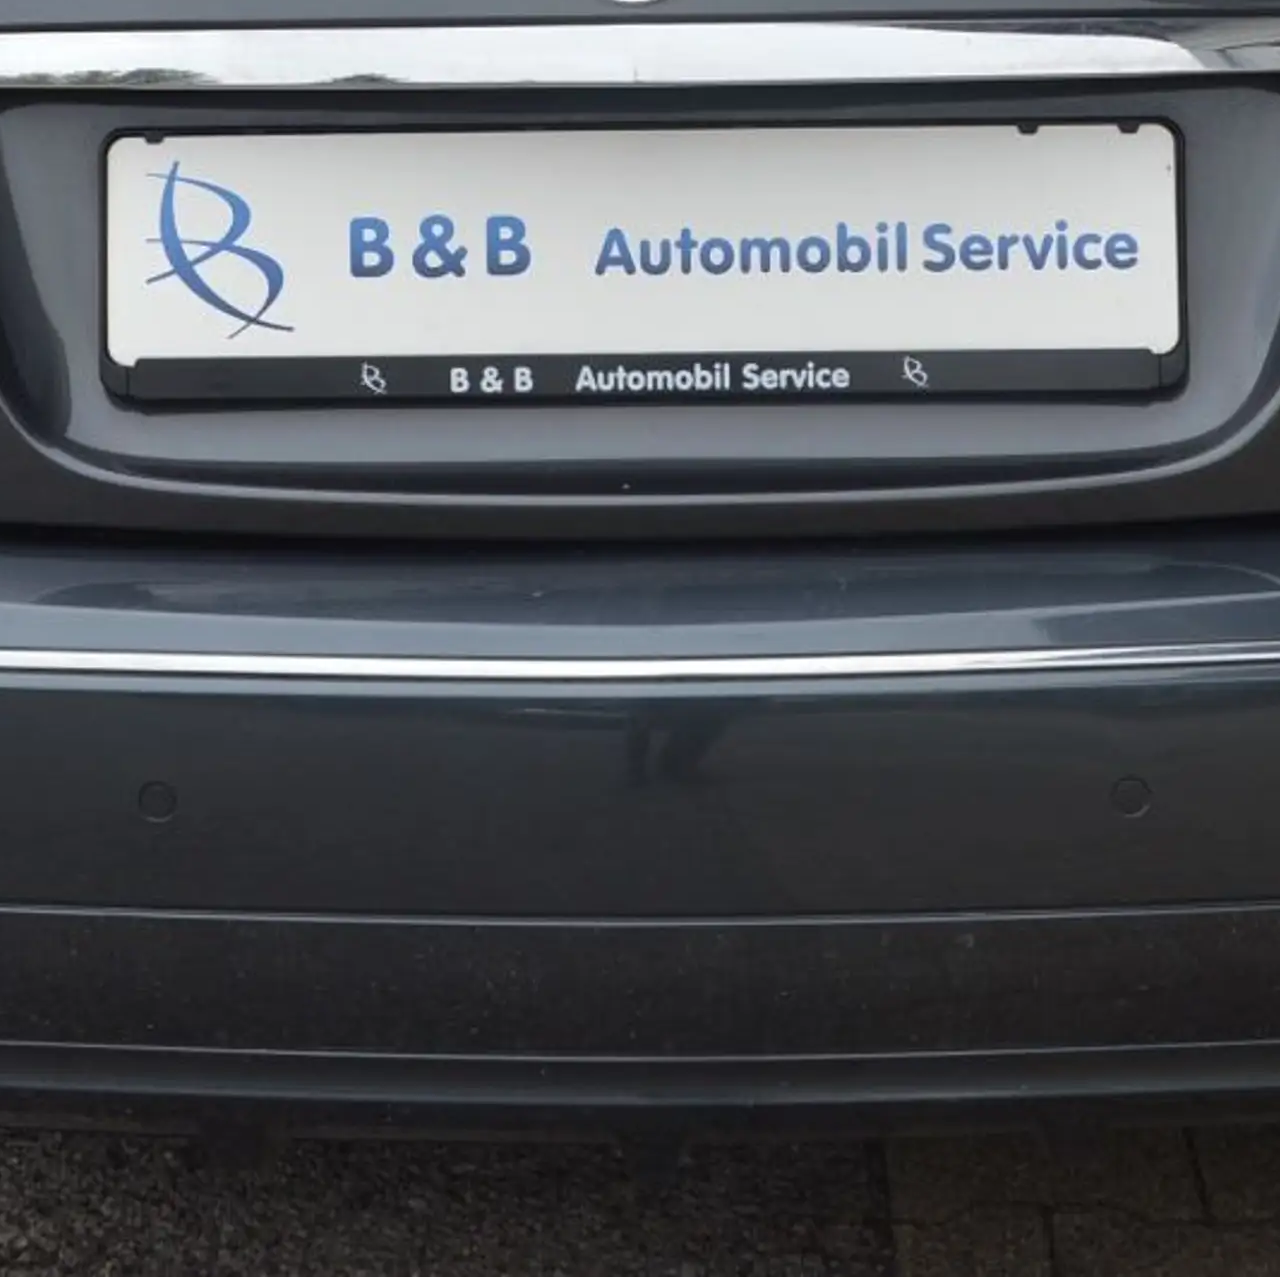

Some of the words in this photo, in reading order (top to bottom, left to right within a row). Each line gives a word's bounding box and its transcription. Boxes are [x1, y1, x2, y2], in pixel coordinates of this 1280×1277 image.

[348, 216, 396, 279] B
[411, 213, 470, 280] &
[485, 214, 533, 278] B
[593, 220, 910, 278] Automobil
[921, 219, 1140, 274] Service
[450, 367, 470, 393] B
[479, 366, 505, 393] &
[513, 366, 534, 393] B
[575, 362, 731, 393] Automobil
[741, 360, 852, 391] Service
